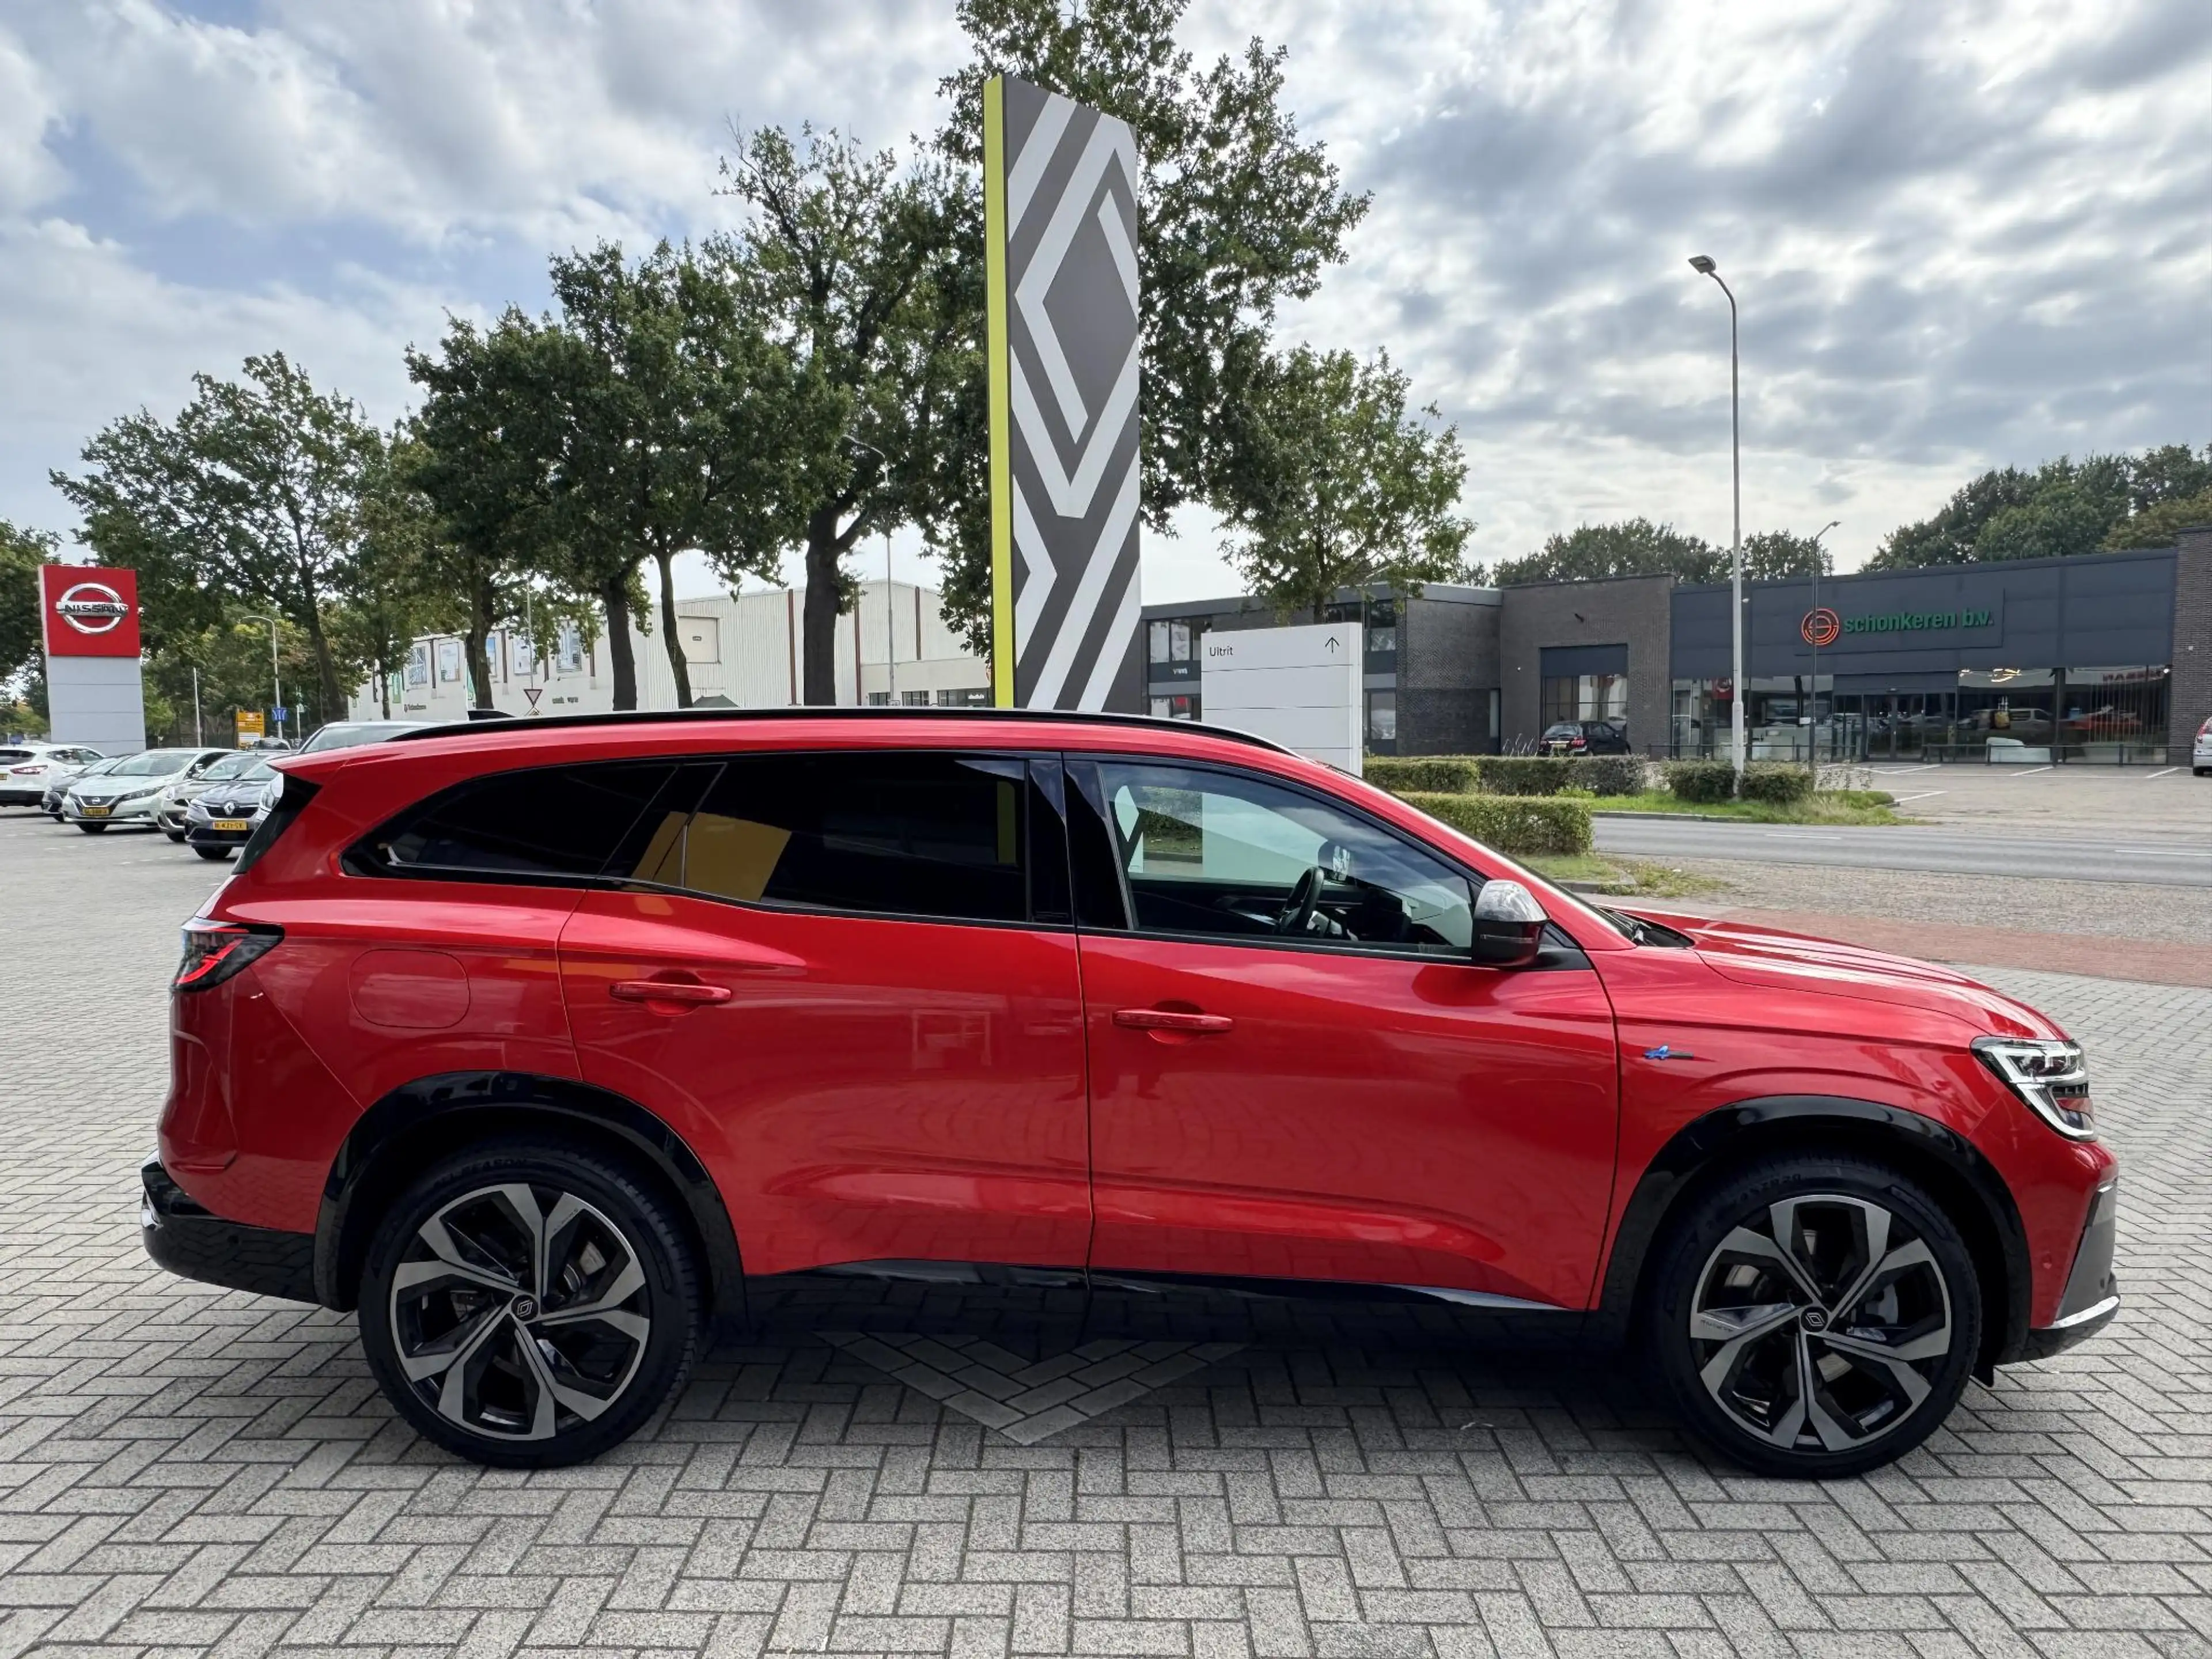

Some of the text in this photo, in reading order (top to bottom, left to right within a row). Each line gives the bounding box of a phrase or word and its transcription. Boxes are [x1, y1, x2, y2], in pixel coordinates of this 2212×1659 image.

[1844, 608, 1994, 632] schonkeren b.v.
[1210, 645, 1233, 656] Uitrit
